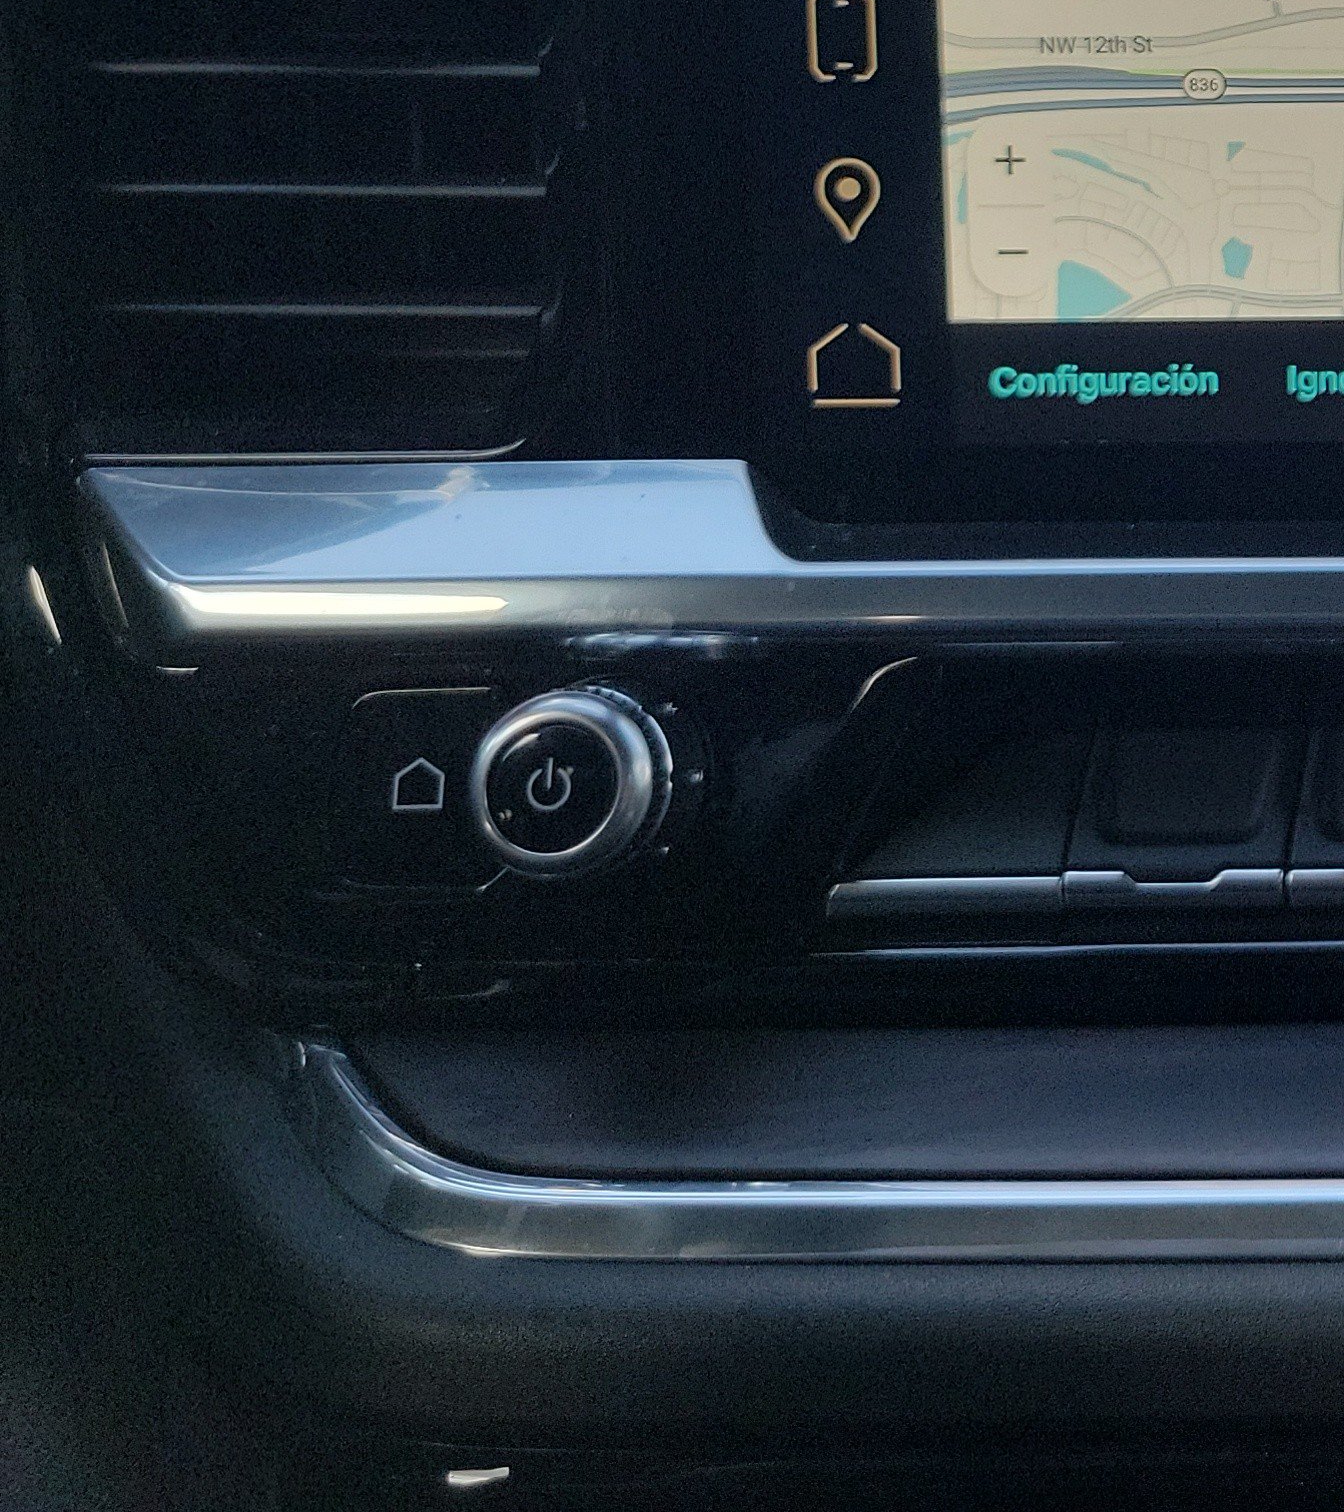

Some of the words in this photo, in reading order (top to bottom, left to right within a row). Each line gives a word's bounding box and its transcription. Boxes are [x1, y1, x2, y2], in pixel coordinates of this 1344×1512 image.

[1040, 36, 1076, 54] NW
[1083, 36, 1126, 54] 12th
[1133, 36, 1153, 54] St
[1189, 76, 1219, 93] 836
[988, 363, 1220, 406] Configuración
